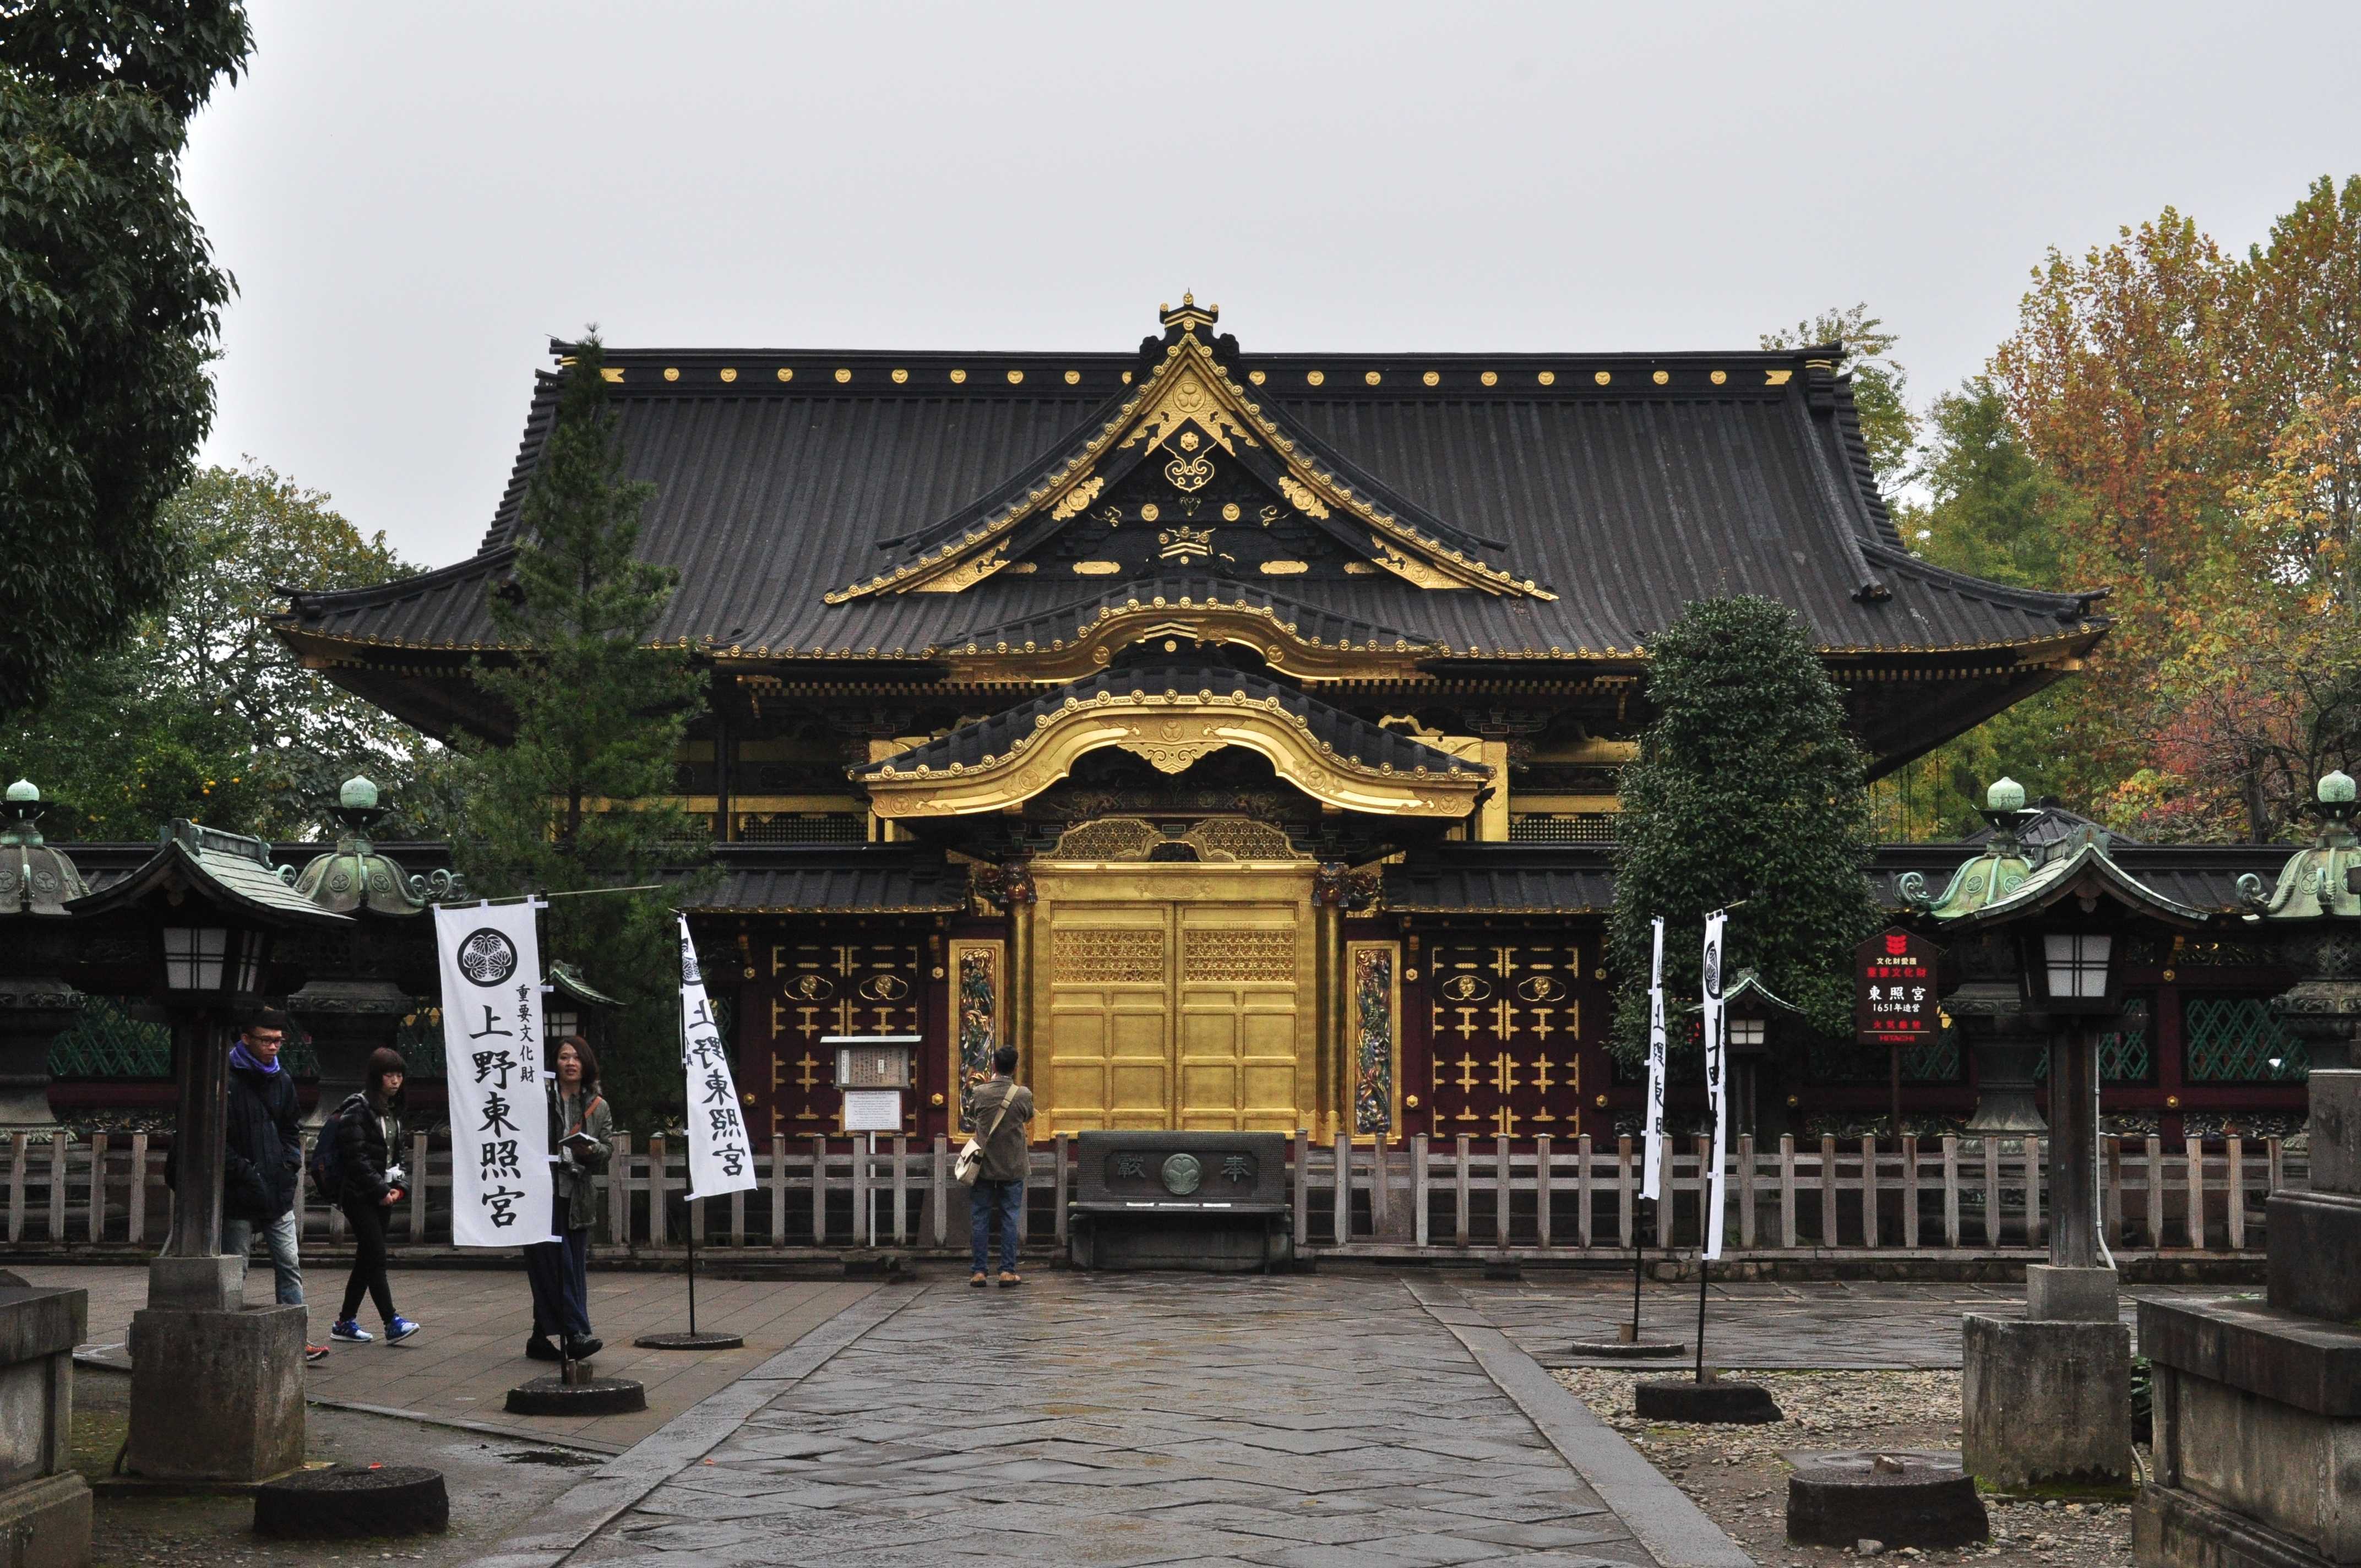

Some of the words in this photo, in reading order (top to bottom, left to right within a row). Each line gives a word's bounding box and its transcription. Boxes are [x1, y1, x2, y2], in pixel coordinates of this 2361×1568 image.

[1868, 985, 1926, 1001] 東照宮
[1873, 1003, 1921, 1012] 1651年造営
[515, 983, 535, 1083] 重要文化財
[469, 1004, 525, 1228] 上野東照宮
